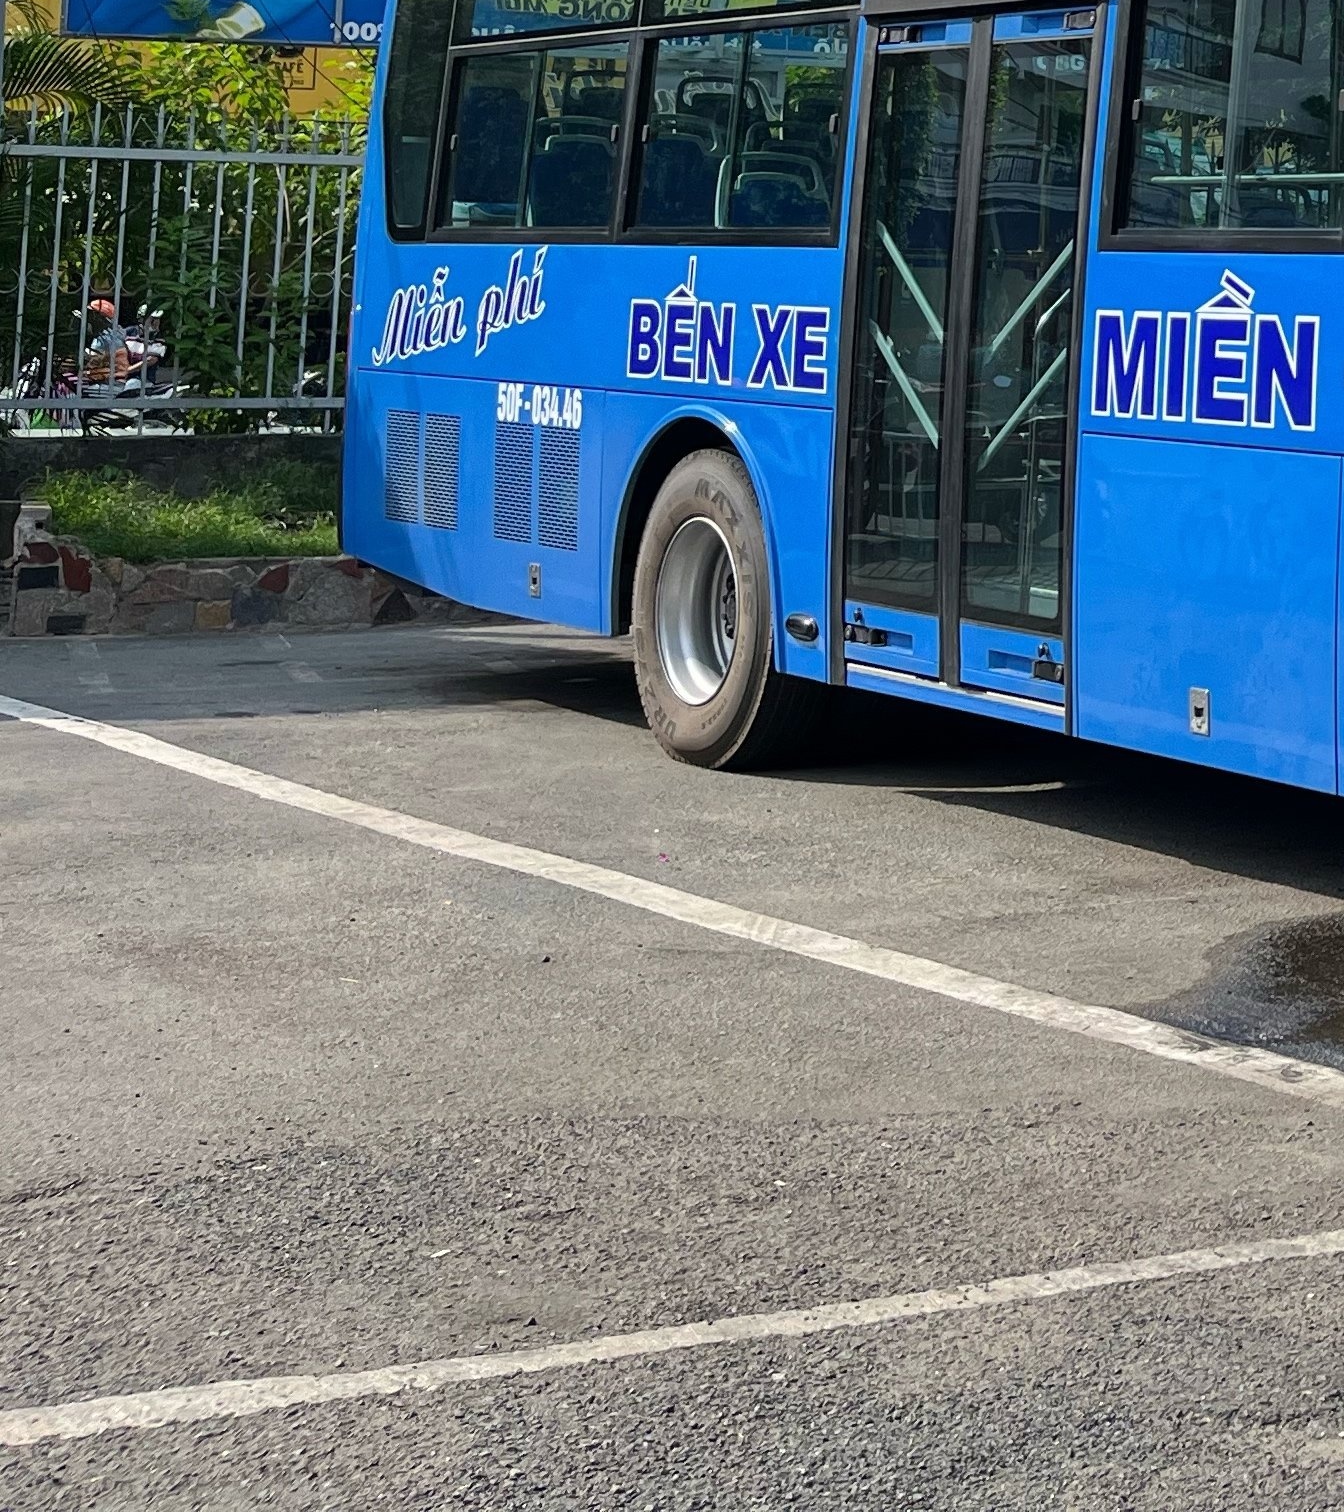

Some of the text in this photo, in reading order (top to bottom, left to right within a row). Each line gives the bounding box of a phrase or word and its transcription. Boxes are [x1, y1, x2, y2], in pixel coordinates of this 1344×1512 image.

[371, 244, 549, 367] Miễn phí
[625, 255, 831, 395] BẾN XE
[1091, 268, 1321, 432] MIỀN
[496, 381, 583, 430] 50F-034.46
